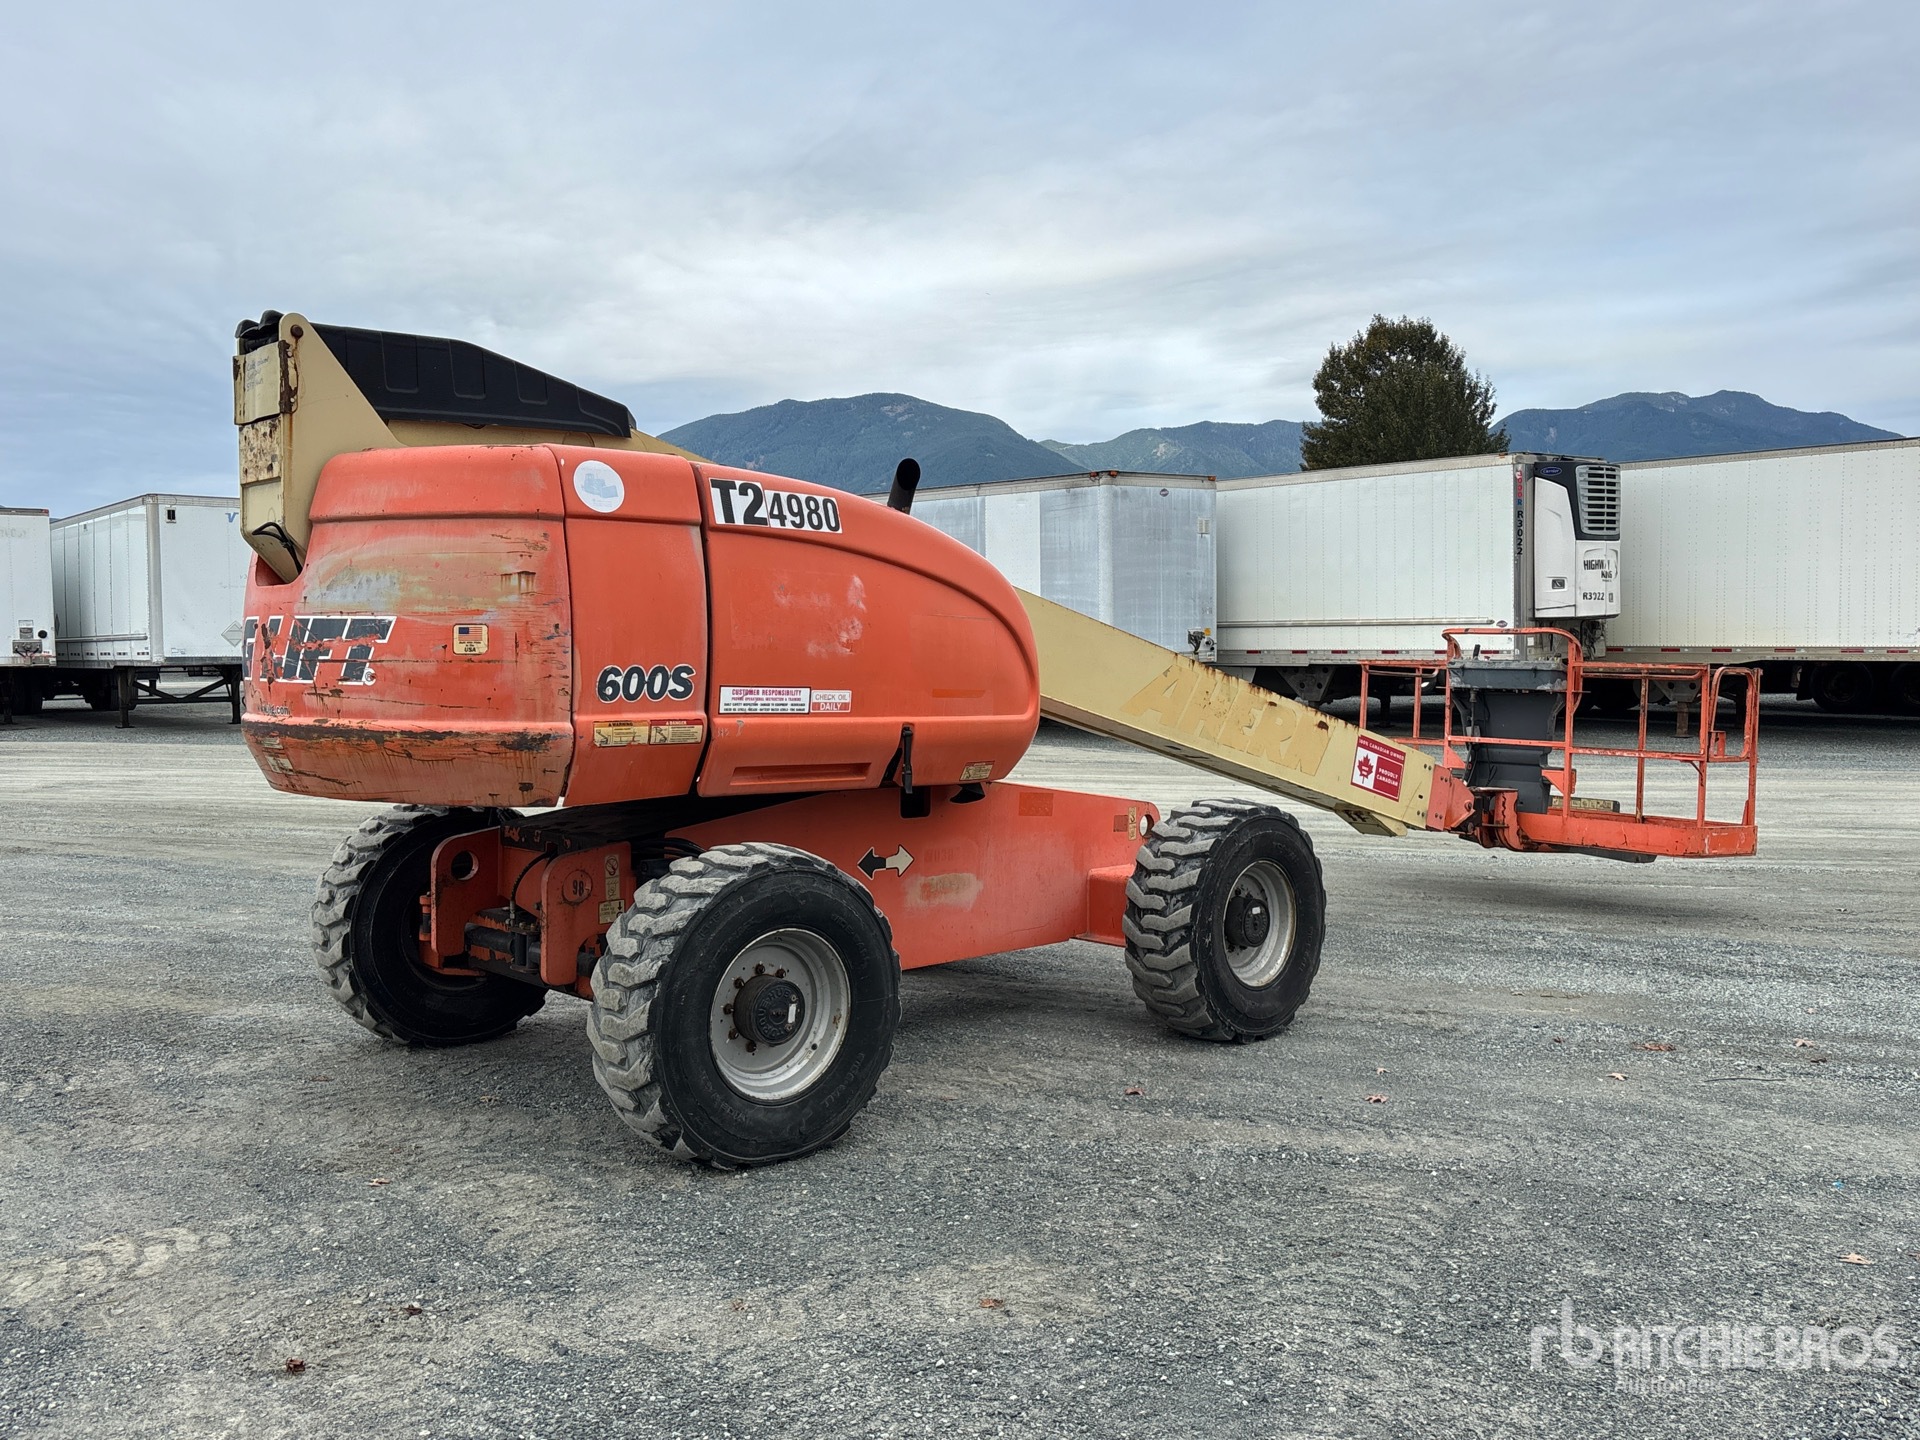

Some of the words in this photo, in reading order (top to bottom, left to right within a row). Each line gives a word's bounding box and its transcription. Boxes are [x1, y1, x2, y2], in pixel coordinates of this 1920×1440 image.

[1516, 510, 1524, 555] R3022
[597, 664, 696, 703] 600S
[732, 688, 760, 696] CUSTOMER
[820, 702, 842, 711] DAILY
[1369, 742, 1390, 754] CANADIAN
[1379, 767, 1398, 779] PROUDLY
